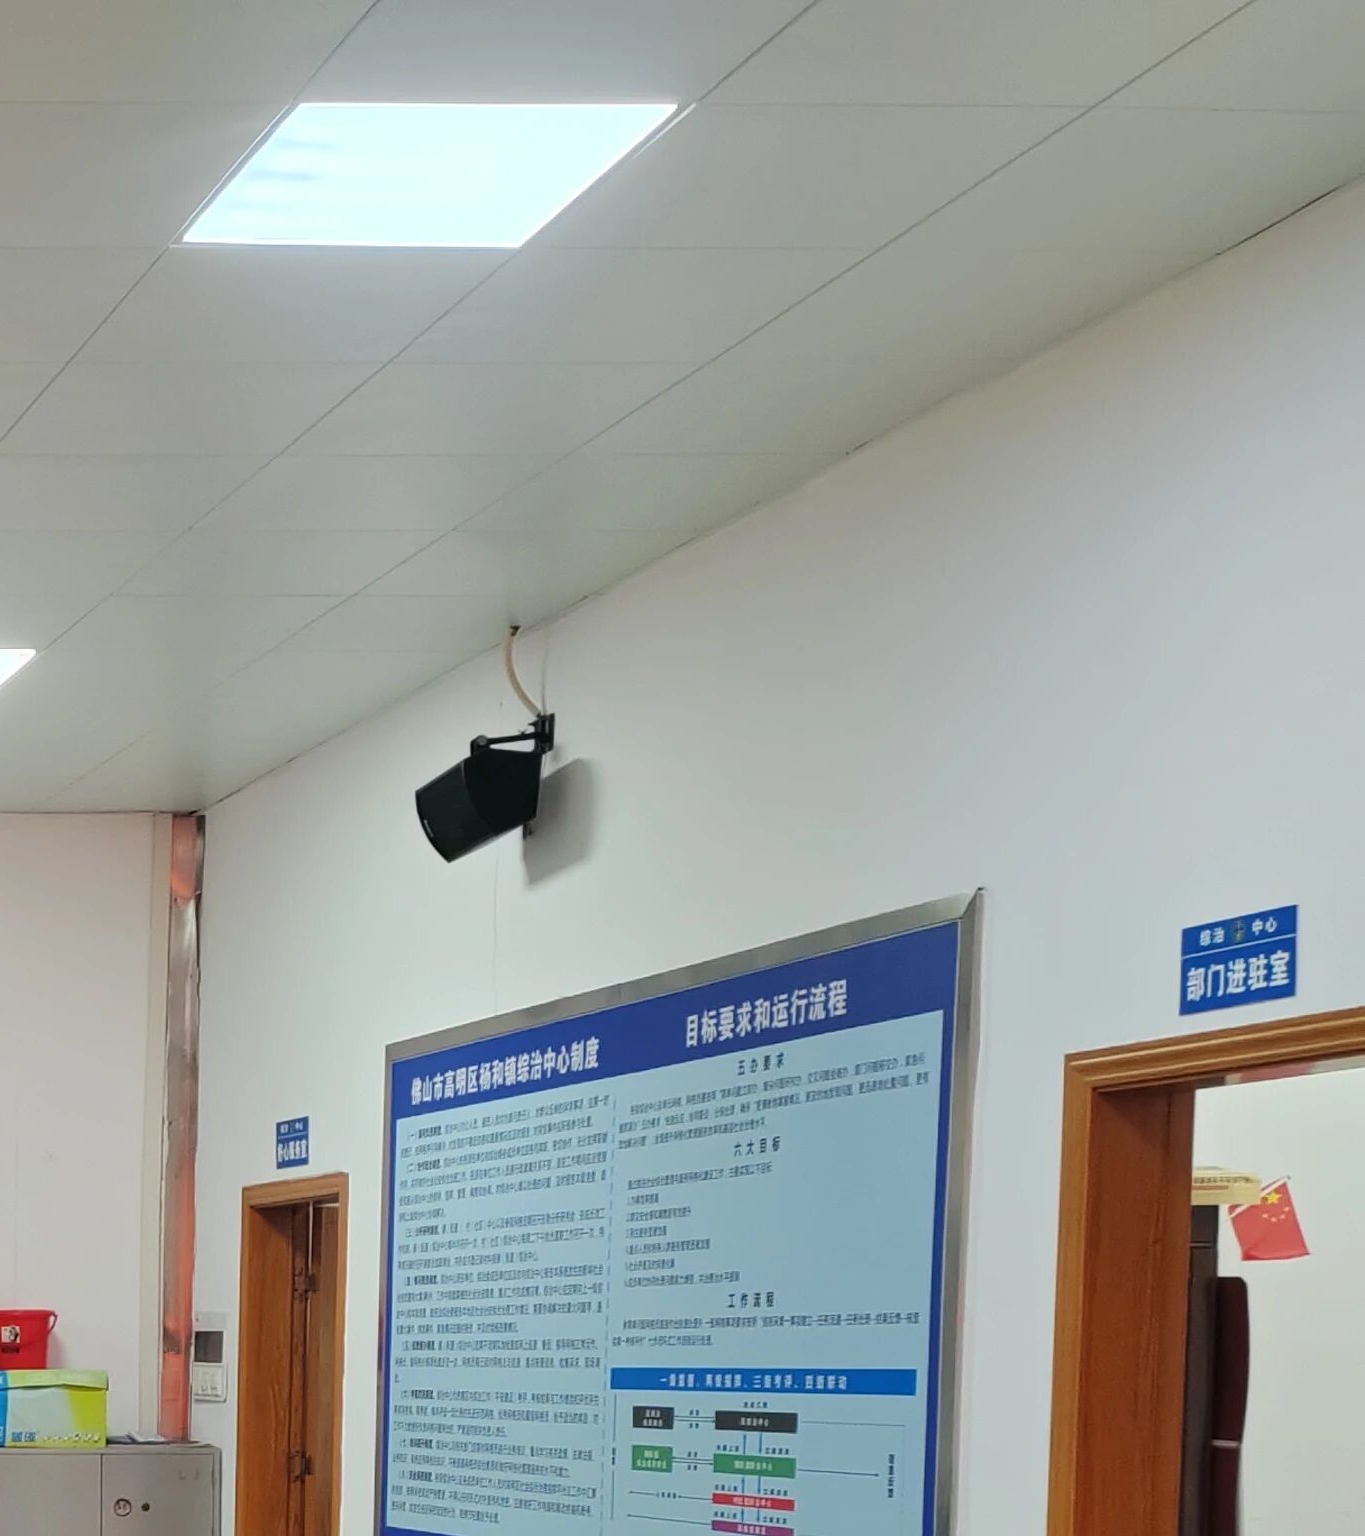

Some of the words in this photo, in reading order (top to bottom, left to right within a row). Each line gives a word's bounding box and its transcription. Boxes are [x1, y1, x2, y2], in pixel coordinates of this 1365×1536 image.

[1200, 927, 1225, 946] 综治
[1252, 917, 1277, 935] 中心
[1186, 950, 1290, 1001] 部门进驻室
[686, 979, 847, 1048] 目标要求和运行流程
[411, 1036, 600, 1105] 佛山市高明区杨和镇综治中心制度
